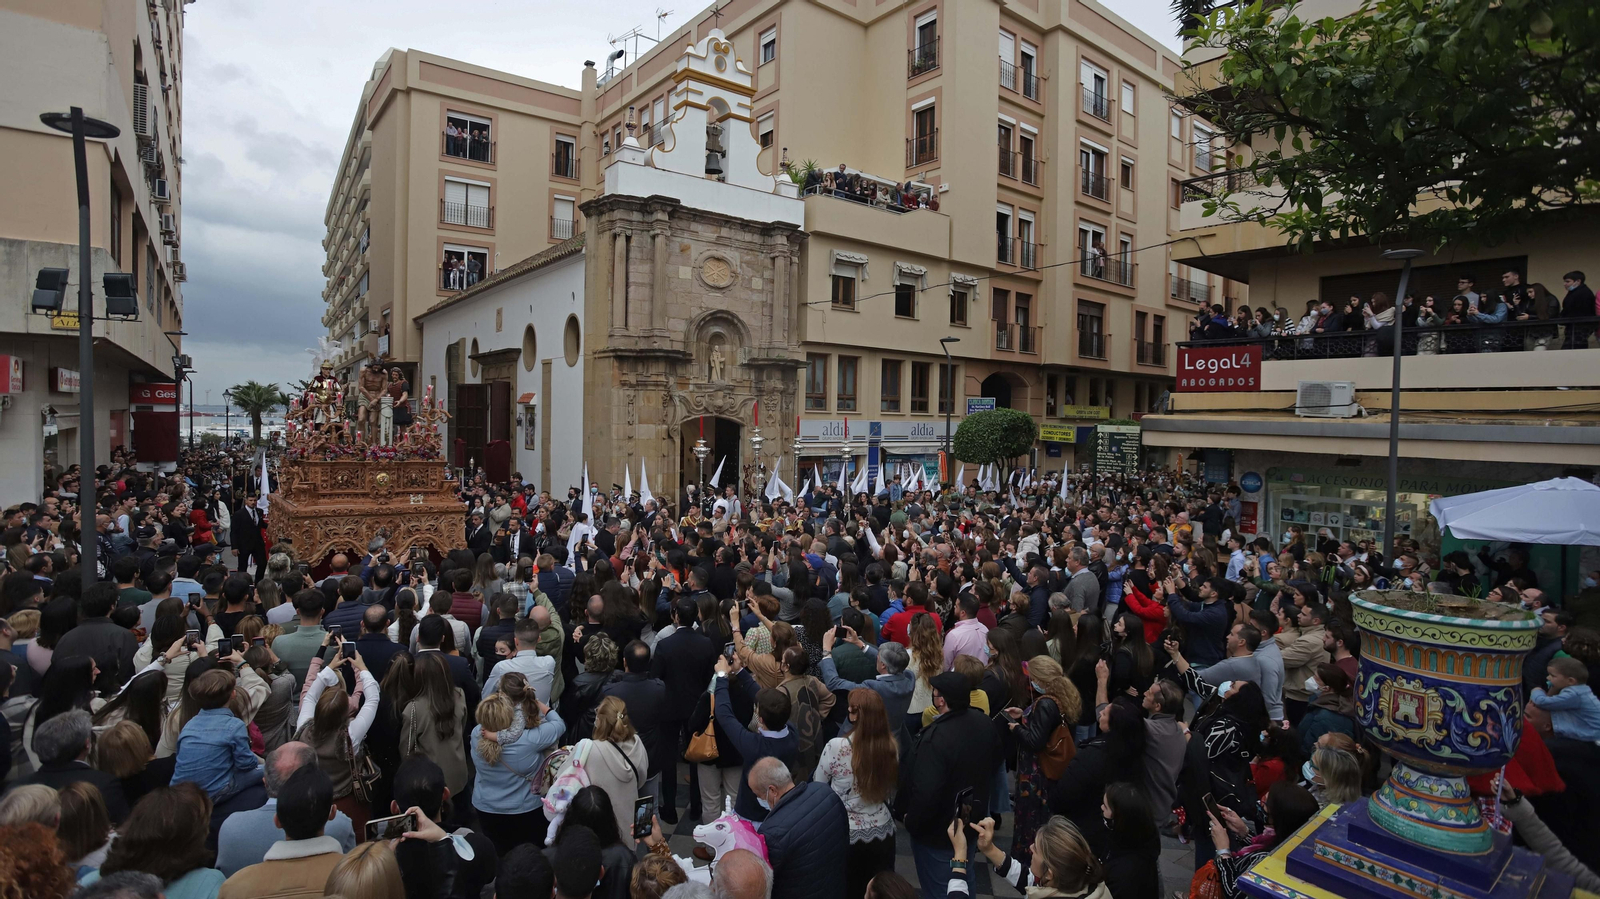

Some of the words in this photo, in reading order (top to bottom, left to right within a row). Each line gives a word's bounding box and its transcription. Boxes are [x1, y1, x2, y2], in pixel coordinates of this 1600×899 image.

[1184, 352, 1252, 374] Legal4
[1181, 377, 1255, 386] ABOGADOS
[1400, 480, 1439, 492] PARA
